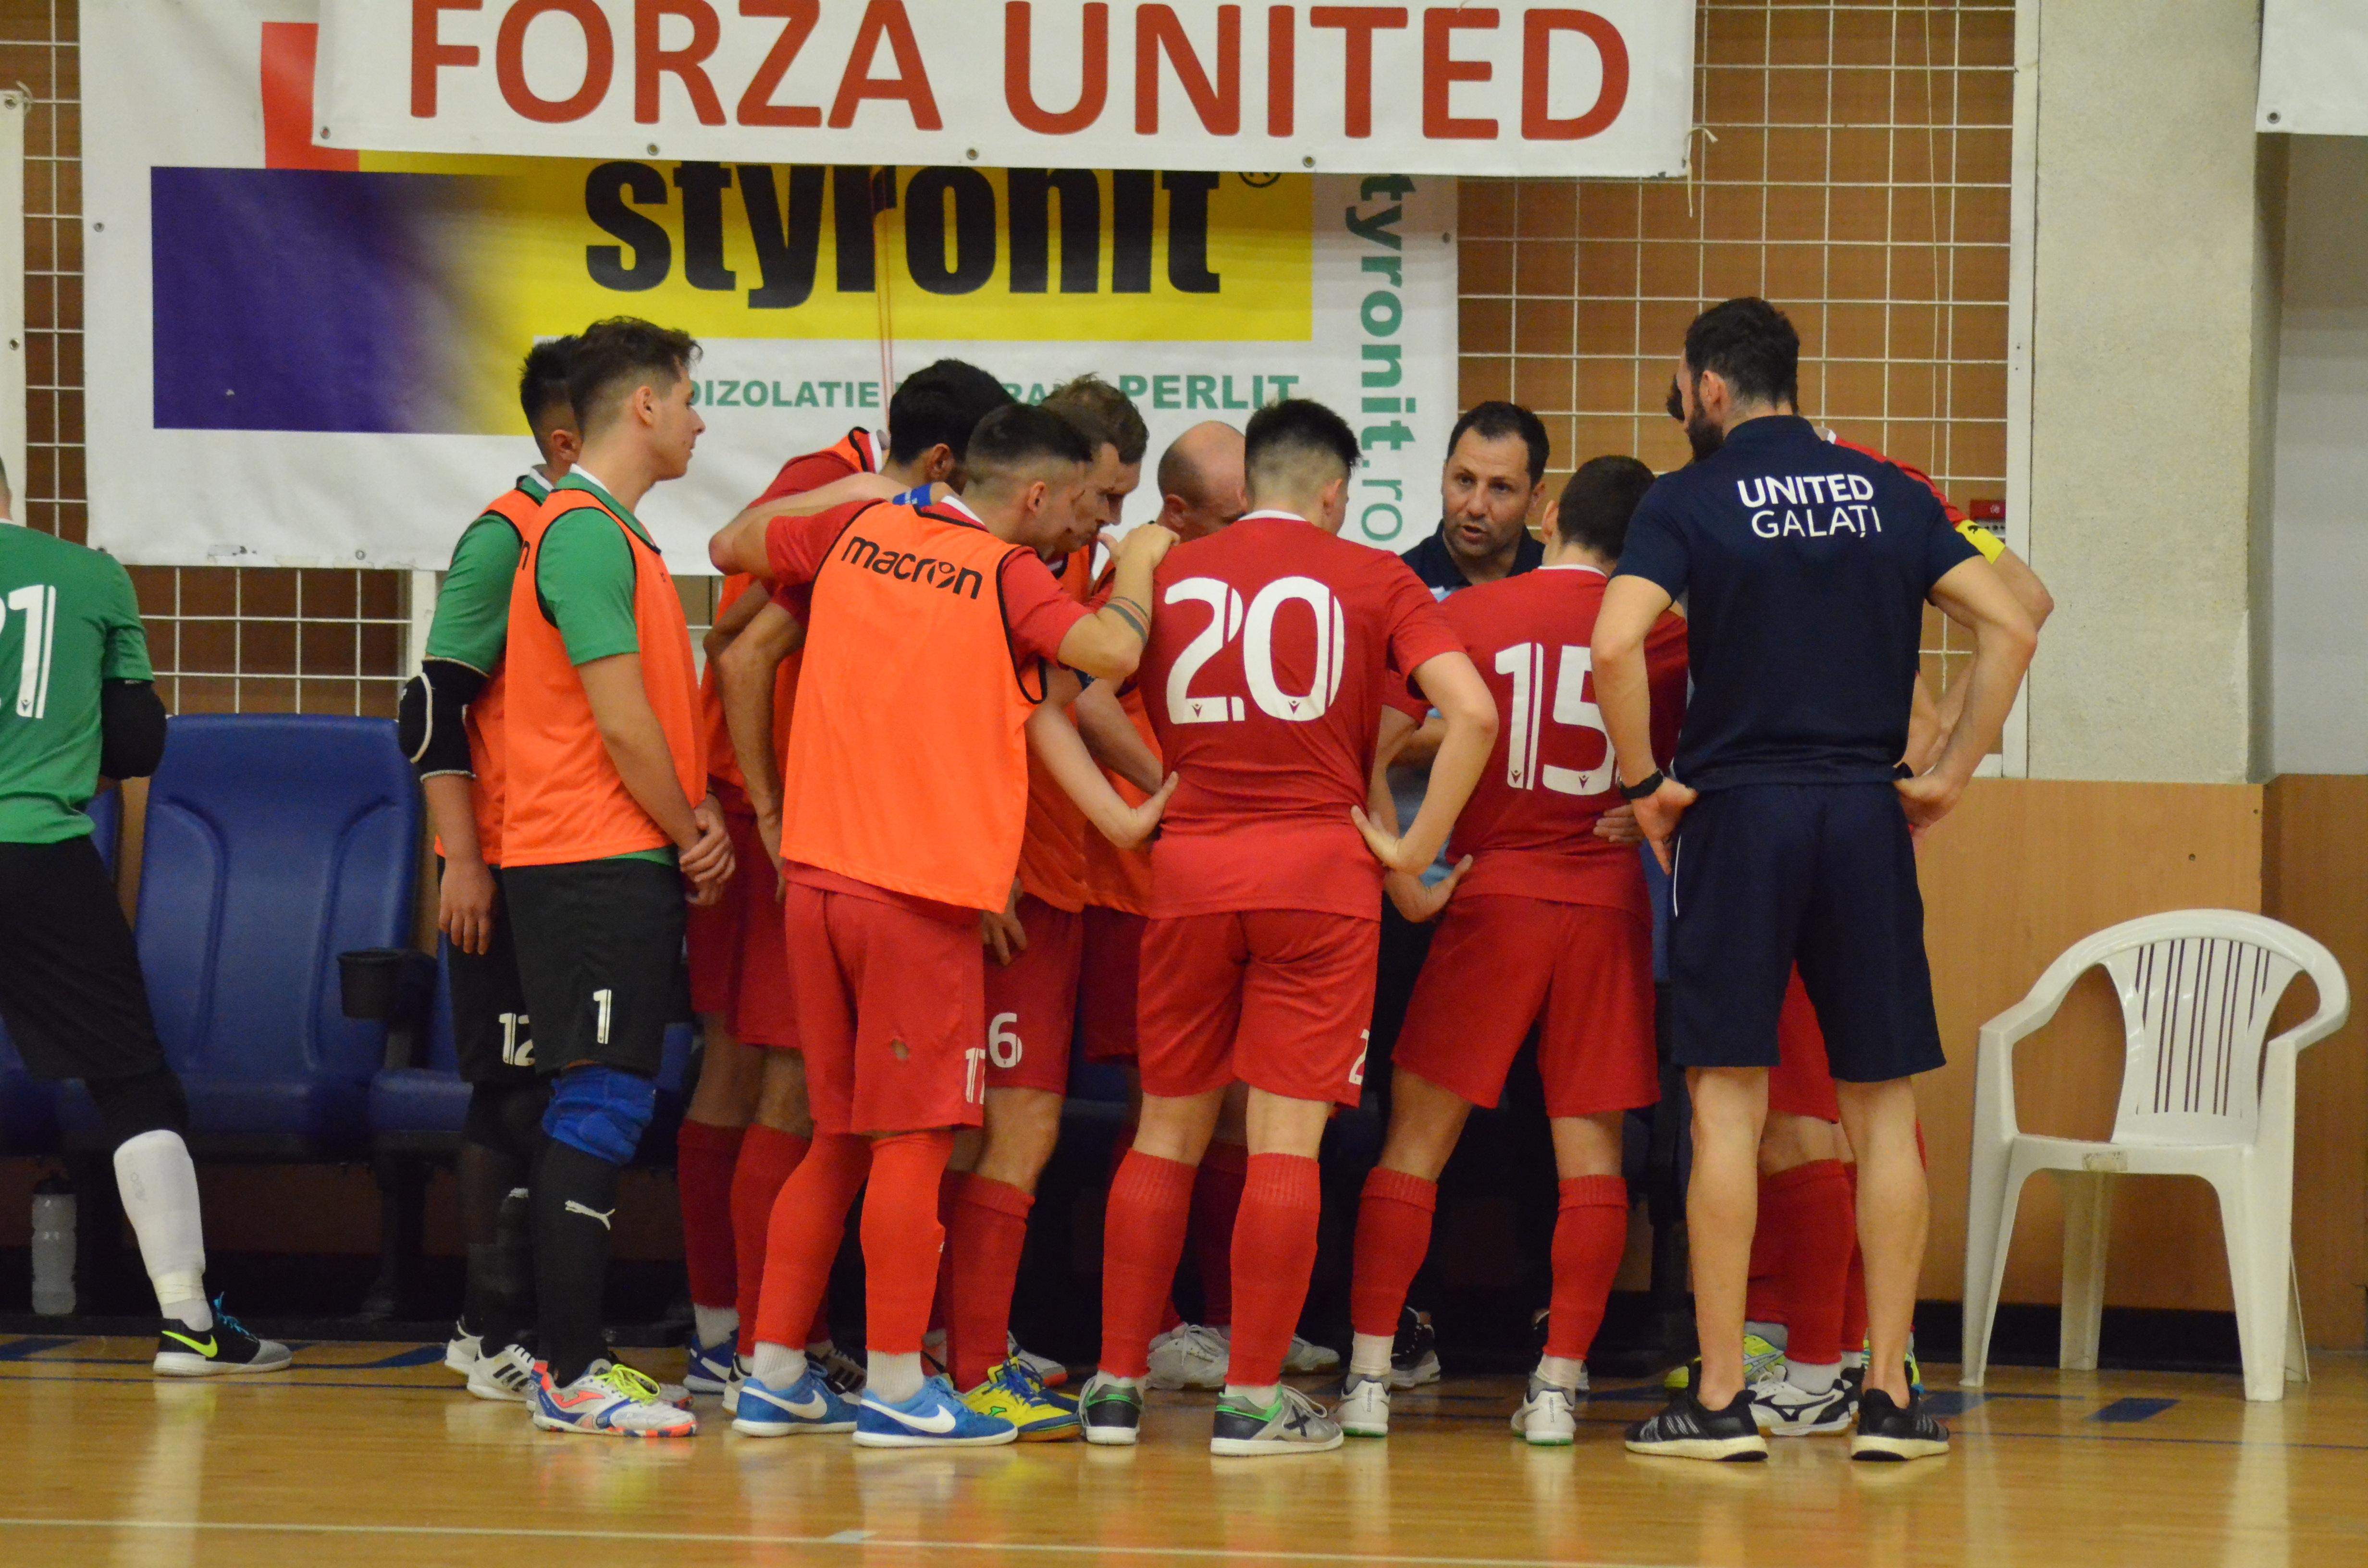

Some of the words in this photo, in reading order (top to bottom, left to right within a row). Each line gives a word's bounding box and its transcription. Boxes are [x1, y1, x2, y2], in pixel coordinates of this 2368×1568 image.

[412, 0, 943, 131] FORZA
[1005, 1, 1629, 140] UNITED
[585, 160, 1221, 309] styronit
[1119, 375, 1299, 410] PERLIT
[1737, 474, 1874, 508] UNITED
[1751, 505, 1882, 539] GALAȚI
[841, 536, 983, 600] macron
[0, 584, 56, 719] 1
[1164, 576, 1344, 724] 20
[1495, 642, 1618, 796] 15
[593, 989, 612, 1044] 1
[988, 1012, 1023, 1068] 6
[965, 1047, 986, 1104] 1
